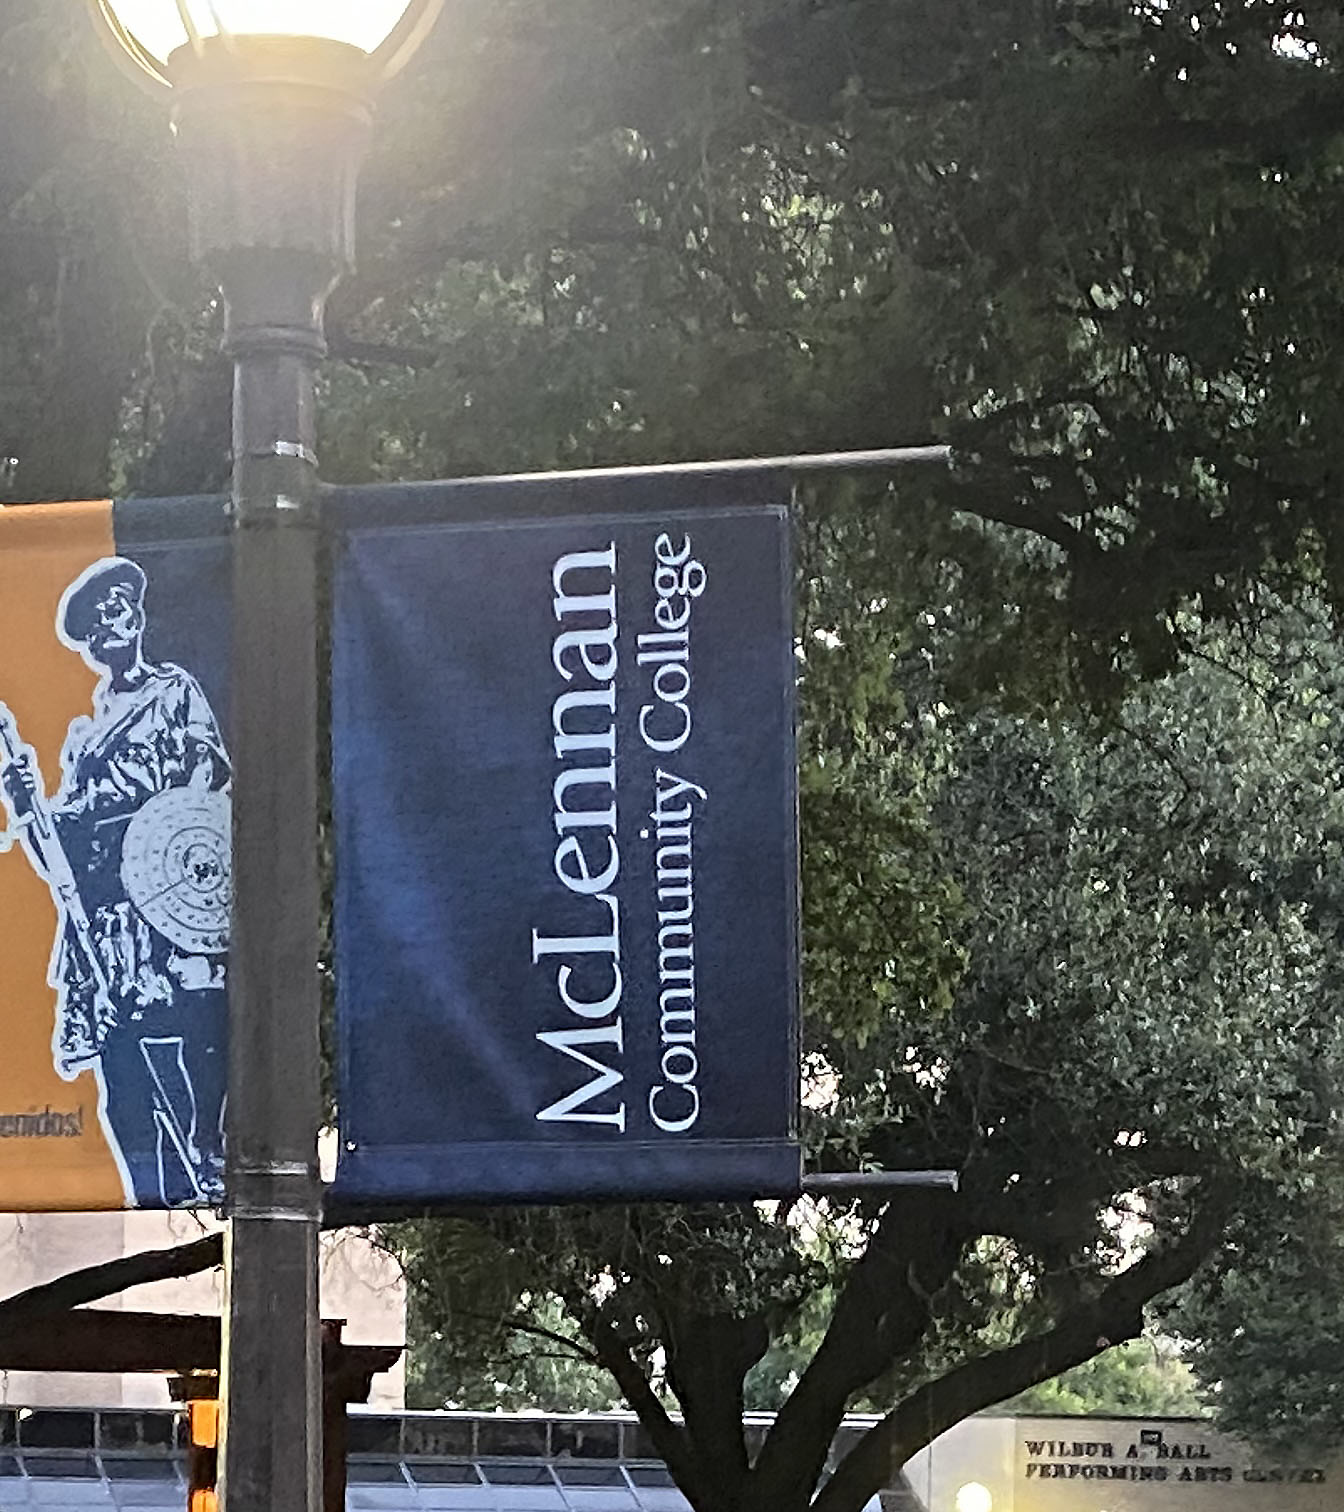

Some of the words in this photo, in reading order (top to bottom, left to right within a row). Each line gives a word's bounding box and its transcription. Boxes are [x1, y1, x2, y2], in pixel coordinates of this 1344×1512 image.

[637, 531, 708, 752] College
[531, 539, 627, 1135] McLennan
[640, 767, 708, 1134] Community
[1024, 1440, 1114, 1458] WILBUR
[1024, 1462, 1169, 1481] PERFORMING
[1178, 1465, 1233, 1482] ARTS
